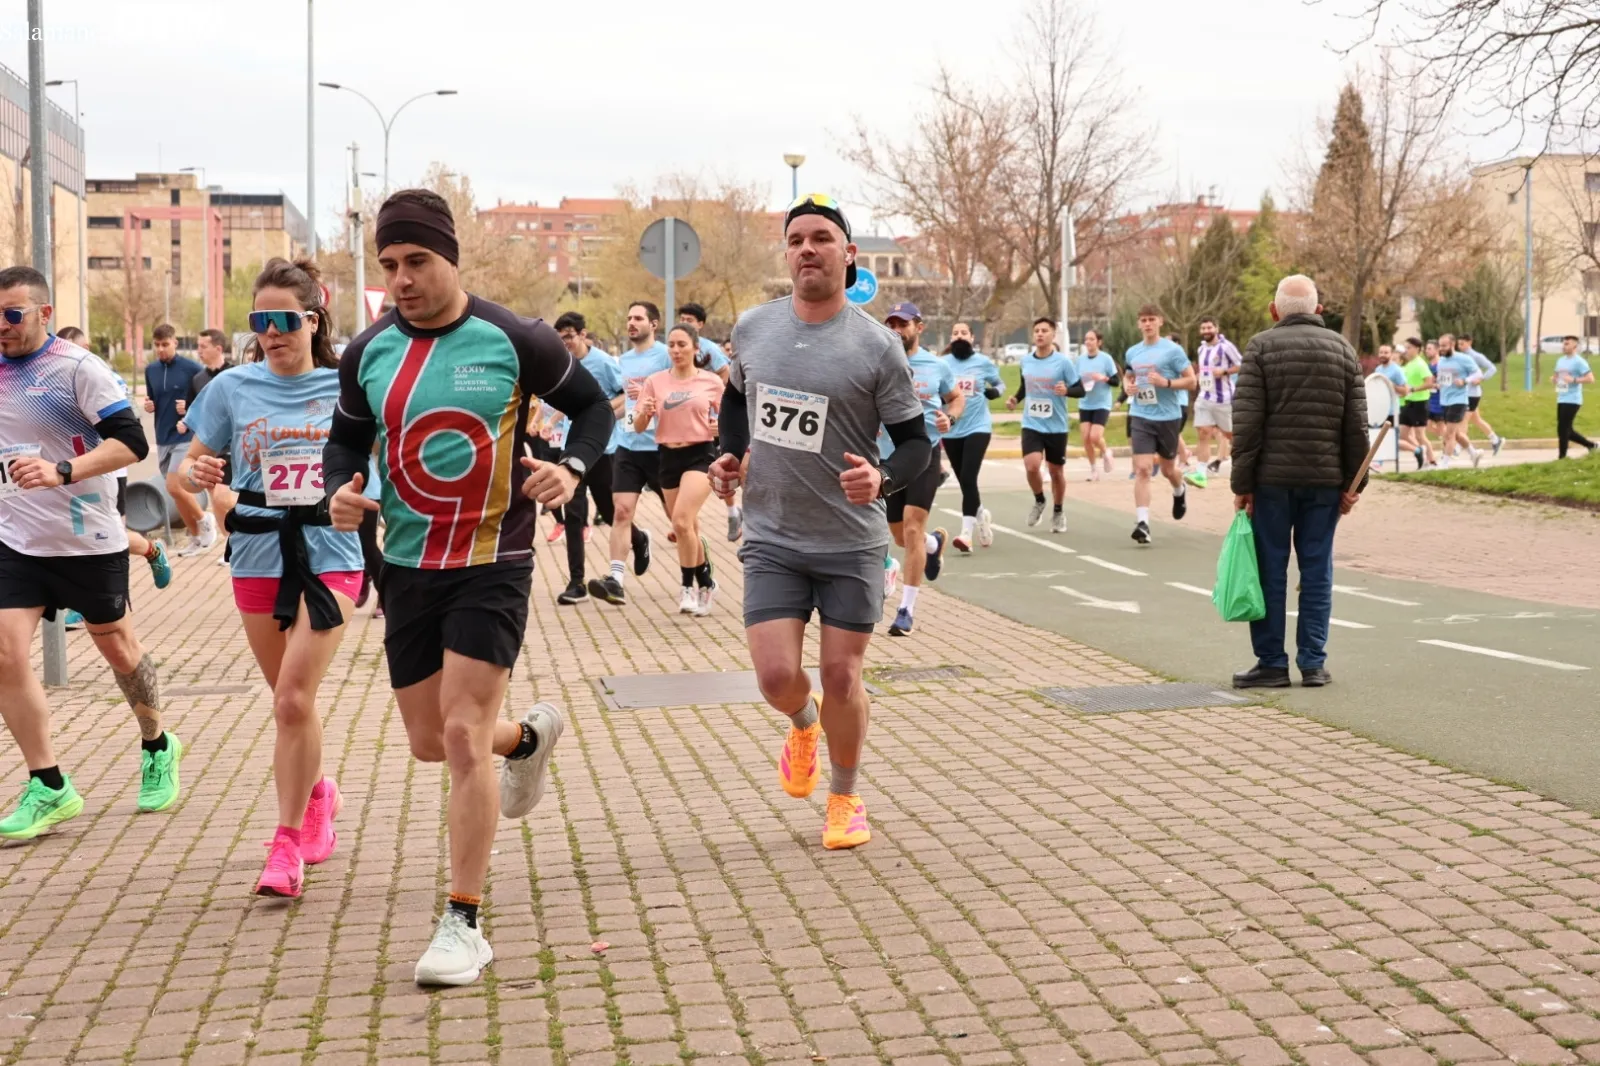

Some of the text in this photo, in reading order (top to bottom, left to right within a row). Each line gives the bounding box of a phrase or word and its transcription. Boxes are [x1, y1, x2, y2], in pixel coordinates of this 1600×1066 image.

[454, 365, 485, 373] XXXIV
[669, 391, 692, 401] NIKE
[1138, 390, 1155, 400] 413
[1030, 403, 1051, 413] 412
[761, 402, 820, 436] 376
[268, 463, 325, 490] 273
